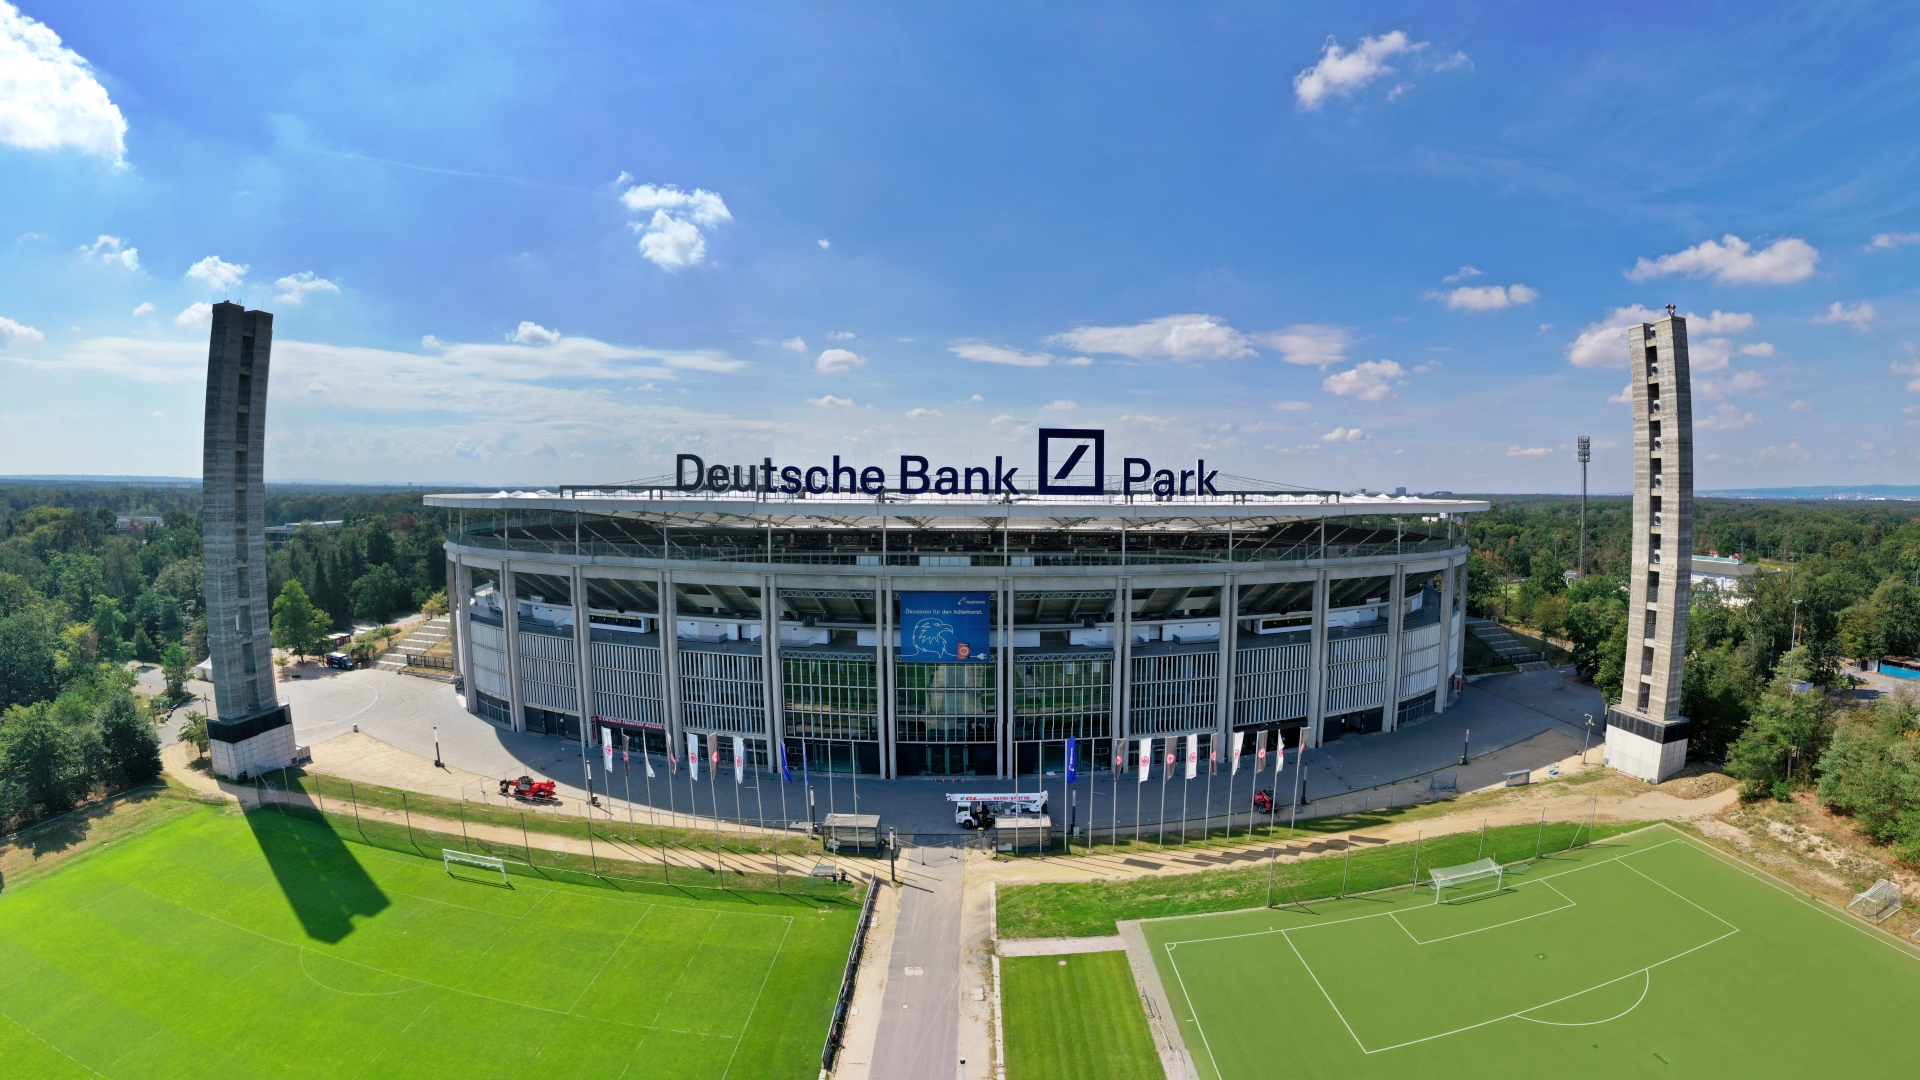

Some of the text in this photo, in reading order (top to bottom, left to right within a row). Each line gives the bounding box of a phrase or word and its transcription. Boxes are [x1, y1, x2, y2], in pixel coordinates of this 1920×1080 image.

[676, 453, 1220, 497] Deutsche Bank Park
[455, 679, 463, 691] 2
